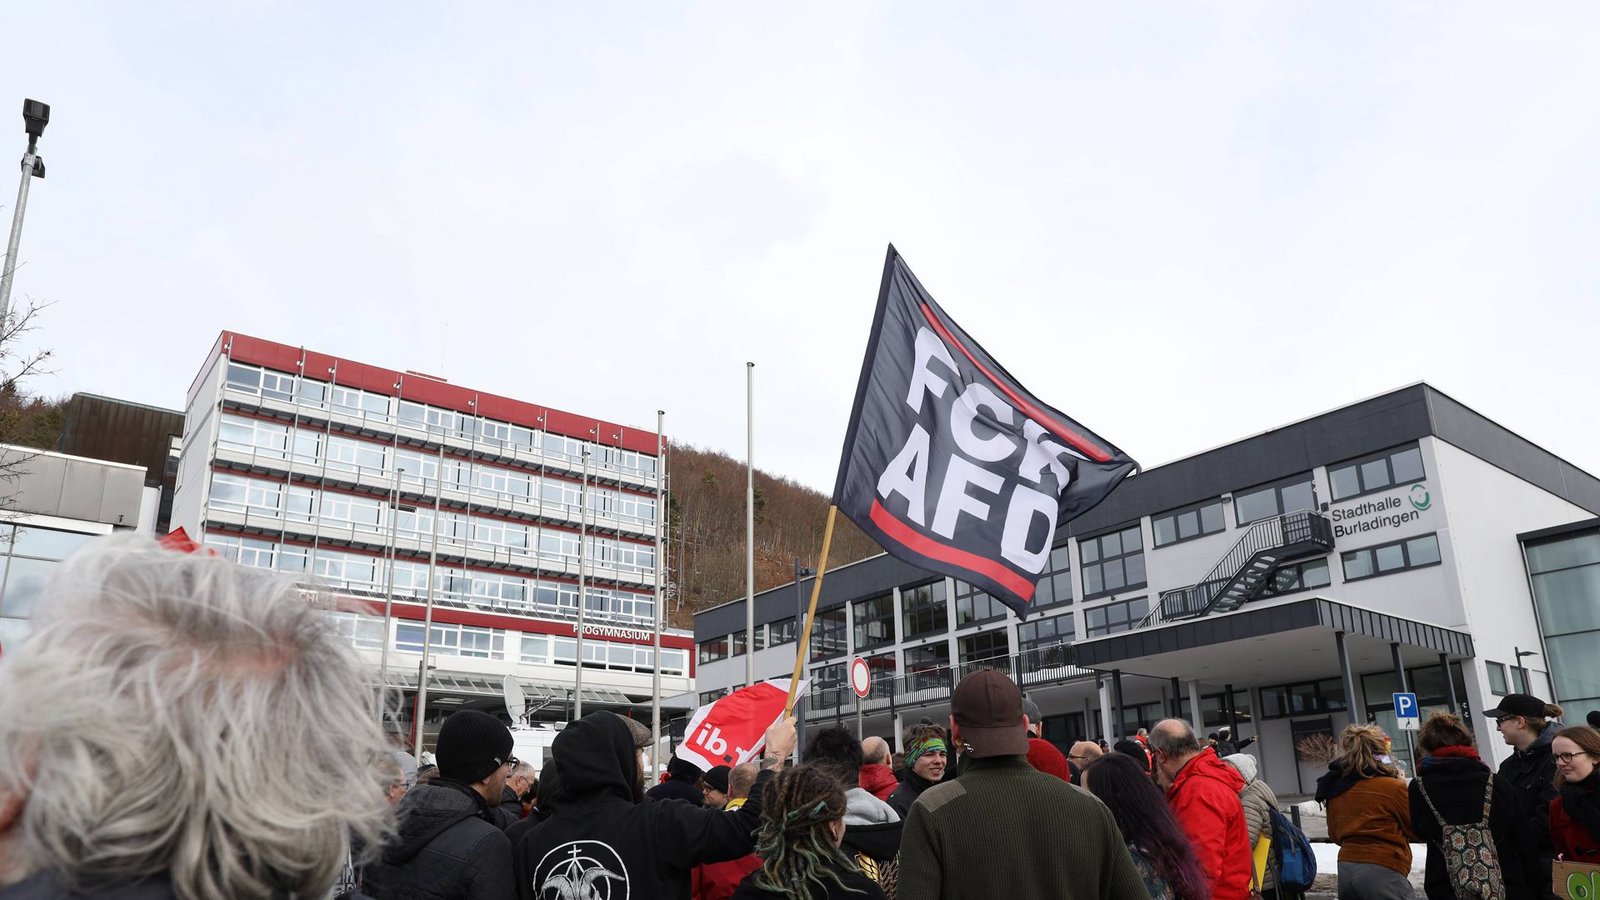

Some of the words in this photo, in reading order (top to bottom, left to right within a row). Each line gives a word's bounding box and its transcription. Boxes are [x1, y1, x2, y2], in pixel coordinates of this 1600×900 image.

[906, 326, 1091, 496] FCK
[876, 423, 1059, 575] AFD
[1332, 497, 1401, 522] Stadthalle
[1334, 510, 1419, 538] Burladingen
[1399, 696, 1411, 715] P
